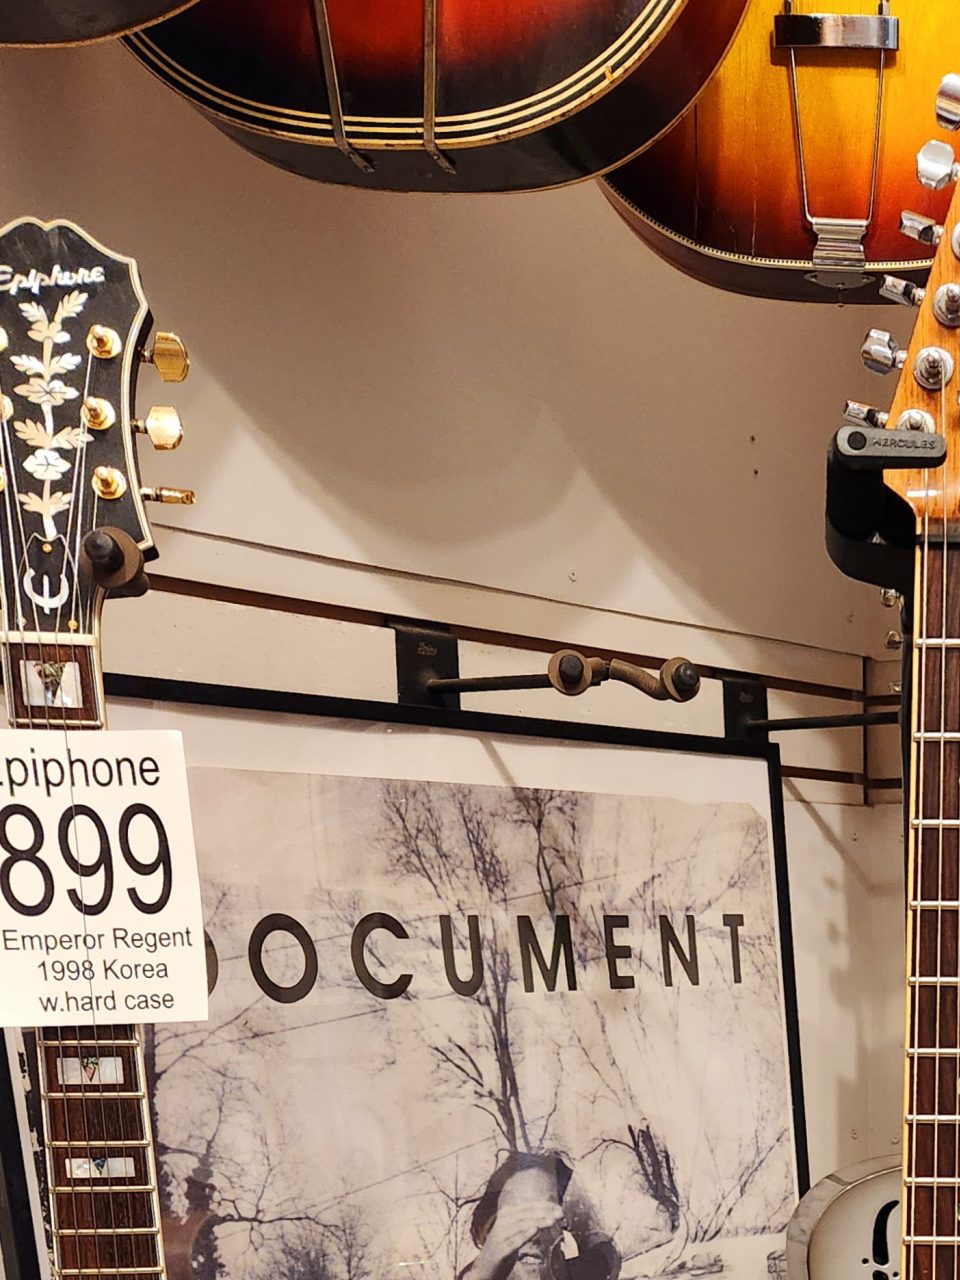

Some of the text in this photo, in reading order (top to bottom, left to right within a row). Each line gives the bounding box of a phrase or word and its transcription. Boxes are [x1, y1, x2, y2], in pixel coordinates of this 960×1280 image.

[0, 264, 106, 296] Epiphone
[873, 438, 937, 450] HERCULES
[0, 748, 161, 797] piphone
[0, 803, 173, 917] 899
[2, 927, 193, 955] Emperor Regent
[37, 958, 169, 982] 1998 Korea
[204, 911, 745, 1004] OCUMENT
[39, 990, 175, 1012] w.hard case
